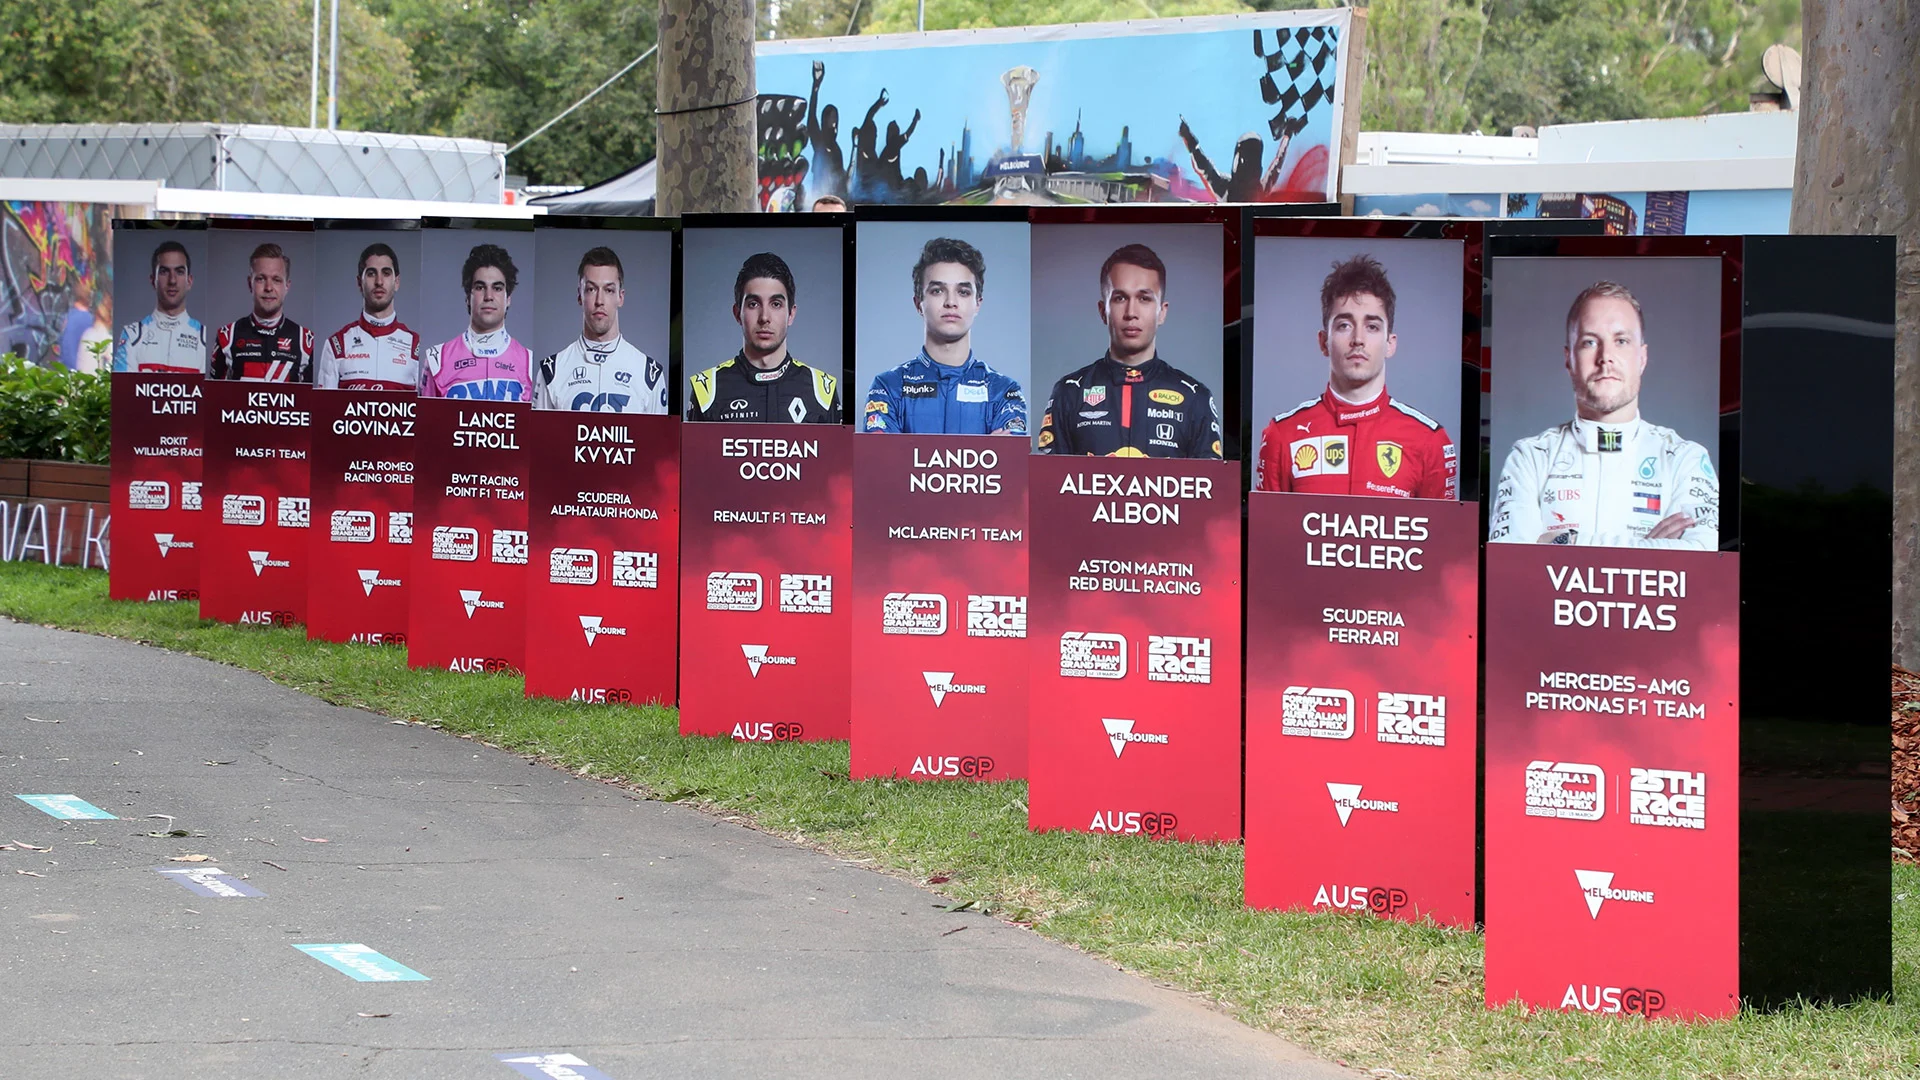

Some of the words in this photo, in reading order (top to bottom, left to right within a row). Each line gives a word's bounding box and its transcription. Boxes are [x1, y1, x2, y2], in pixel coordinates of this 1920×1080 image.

[455, 359, 476, 369] JCB
[136, 384, 202, 398] NICHOLA
[568, 379, 592, 387] HONDA
[248, 392, 294, 407] KEVIN
[1158, 393, 1180, 402] RAUCH
[152, 400, 196, 414] LATIFI
[1147, 408, 1174, 418] Mobil
[222, 410, 310, 426] MAGNUSSE
[459, 411, 515, 429] LANCE
[721, 412, 758, 420] INFINITI
[333, 420, 415, 436] GIOVINAZ
[577, 424, 634, 443] DANIIL
[160, 437, 188, 445] ROKIT
[453, 431, 519, 449] STROLL
[722, 438, 818, 458] ESTEBAN
[1149, 439, 1178, 448] HONDA
[134, 447, 179, 456] WILLIAMS
[180, 448, 203, 456] RACI
[236, 448, 264, 457] HAAS
[265, 449, 275, 458] F1
[279, 450, 306, 459] TEAM
[575, 446, 635, 465] KVYAT
[914, 448, 998, 469] LANDO
[1326, 448, 1344, 465] ups
[349, 461, 375, 470] ALFA
[377, 462, 413, 471] ROMEO
[740, 462, 800, 480] OCON
[344, 472, 382, 483] RACING
[452, 473, 478, 484] BWT
[480, 475, 519, 487] RACING
[910, 473, 1001, 494] NORRIS
[446, 486, 477, 497] POINT
[480, 488, 490, 498] F1
[495, 489, 524, 500] TEAM
[1060, 473, 1212, 499] ALEXANDER
[578, 492, 631, 504] SCUDERIA
[1557, 490, 1581, 501] UBS
[551, 505, 617, 518] ALPHATAURI
[620, 508, 658, 520] HONDA
[714, 510, 770, 523] RENAULT
[773, 512, 785, 524] F1
[790, 512, 826, 524] TEAM
[1092, 502, 1179, 525] ALBON
[889, 526, 958, 540] MCLAREN
[961, 528, 976, 540] F1
[982, 529, 1022, 541] TEAM
[1303, 512, 1429, 541] CHARLES
[613, 551, 657, 567] 25TH
[1306, 542, 1423, 571] LECLERC
[1078, 560, 1132, 574] ASTON
[1135, 562, 1193, 576] MARTIN
[612, 580, 657, 588] MELBOURNE
[781, 574, 832, 590] 25TH
[1069, 576, 1099, 590] RED
[1102, 578, 1140, 592] BULL
[1144, 580, 1201, 595] RACING
[1546, 565, 1686, 597] VALTTERI
[147, 590, 199, 602] AUSGP
[968, 595, 1026, 613] 25TH
[780, 605, 832, 614] MELBOURNE
[1322, 608, 1405, 627] SCUDERIA
[1554, 599, 1677, 632] BOTTAS
[240, 611, 294, 625] AUSGP
[583, 626, 626, 635] MELBOURNE
[968, 628, 1026, 638] MELBOURNE
[1329, 628, 1398, 646] FERRARI
[350, 633, 405, 646] AUSGP
[1149, 636, 1210, 656] 25TH
[449, 657, 508, 673] AUSGP
[746, 656, 796, 665] MELBOURNE
[1149, 672, 1210, 683] MELBOURNE
[571, 688, 631, 704] AUSGP
[928, 684, 986, 693] MELBOURNE
[1378, 692, 1445, 716] 25TH
[1526, 692, 1624, 714] PETRONAS
[1628, 698, 1646, 715] F1
[1654, 699, 1704, 719] TEAM
[730, 722, 803, 742] AUSGP
[1108, 732, 1168, 744] MELBOURNE
[1377, 732, 1445, 746] MELBOURNE
[910, 756, 994, 777] AUSGP
[1630, 767, 1705, 795] 25TH
[1333, 798, 1398, 812] MELBOURNE
[1089, 810, 1177, 835] AUSGP
[1630, 814, 1705, 829] MELBOURNE
[1313, 884, 1407, 913] AUSGP
[1582, 887, 1654, 903] MELBOURNE
[1561, 983, 1665, 1018] AUSGP
